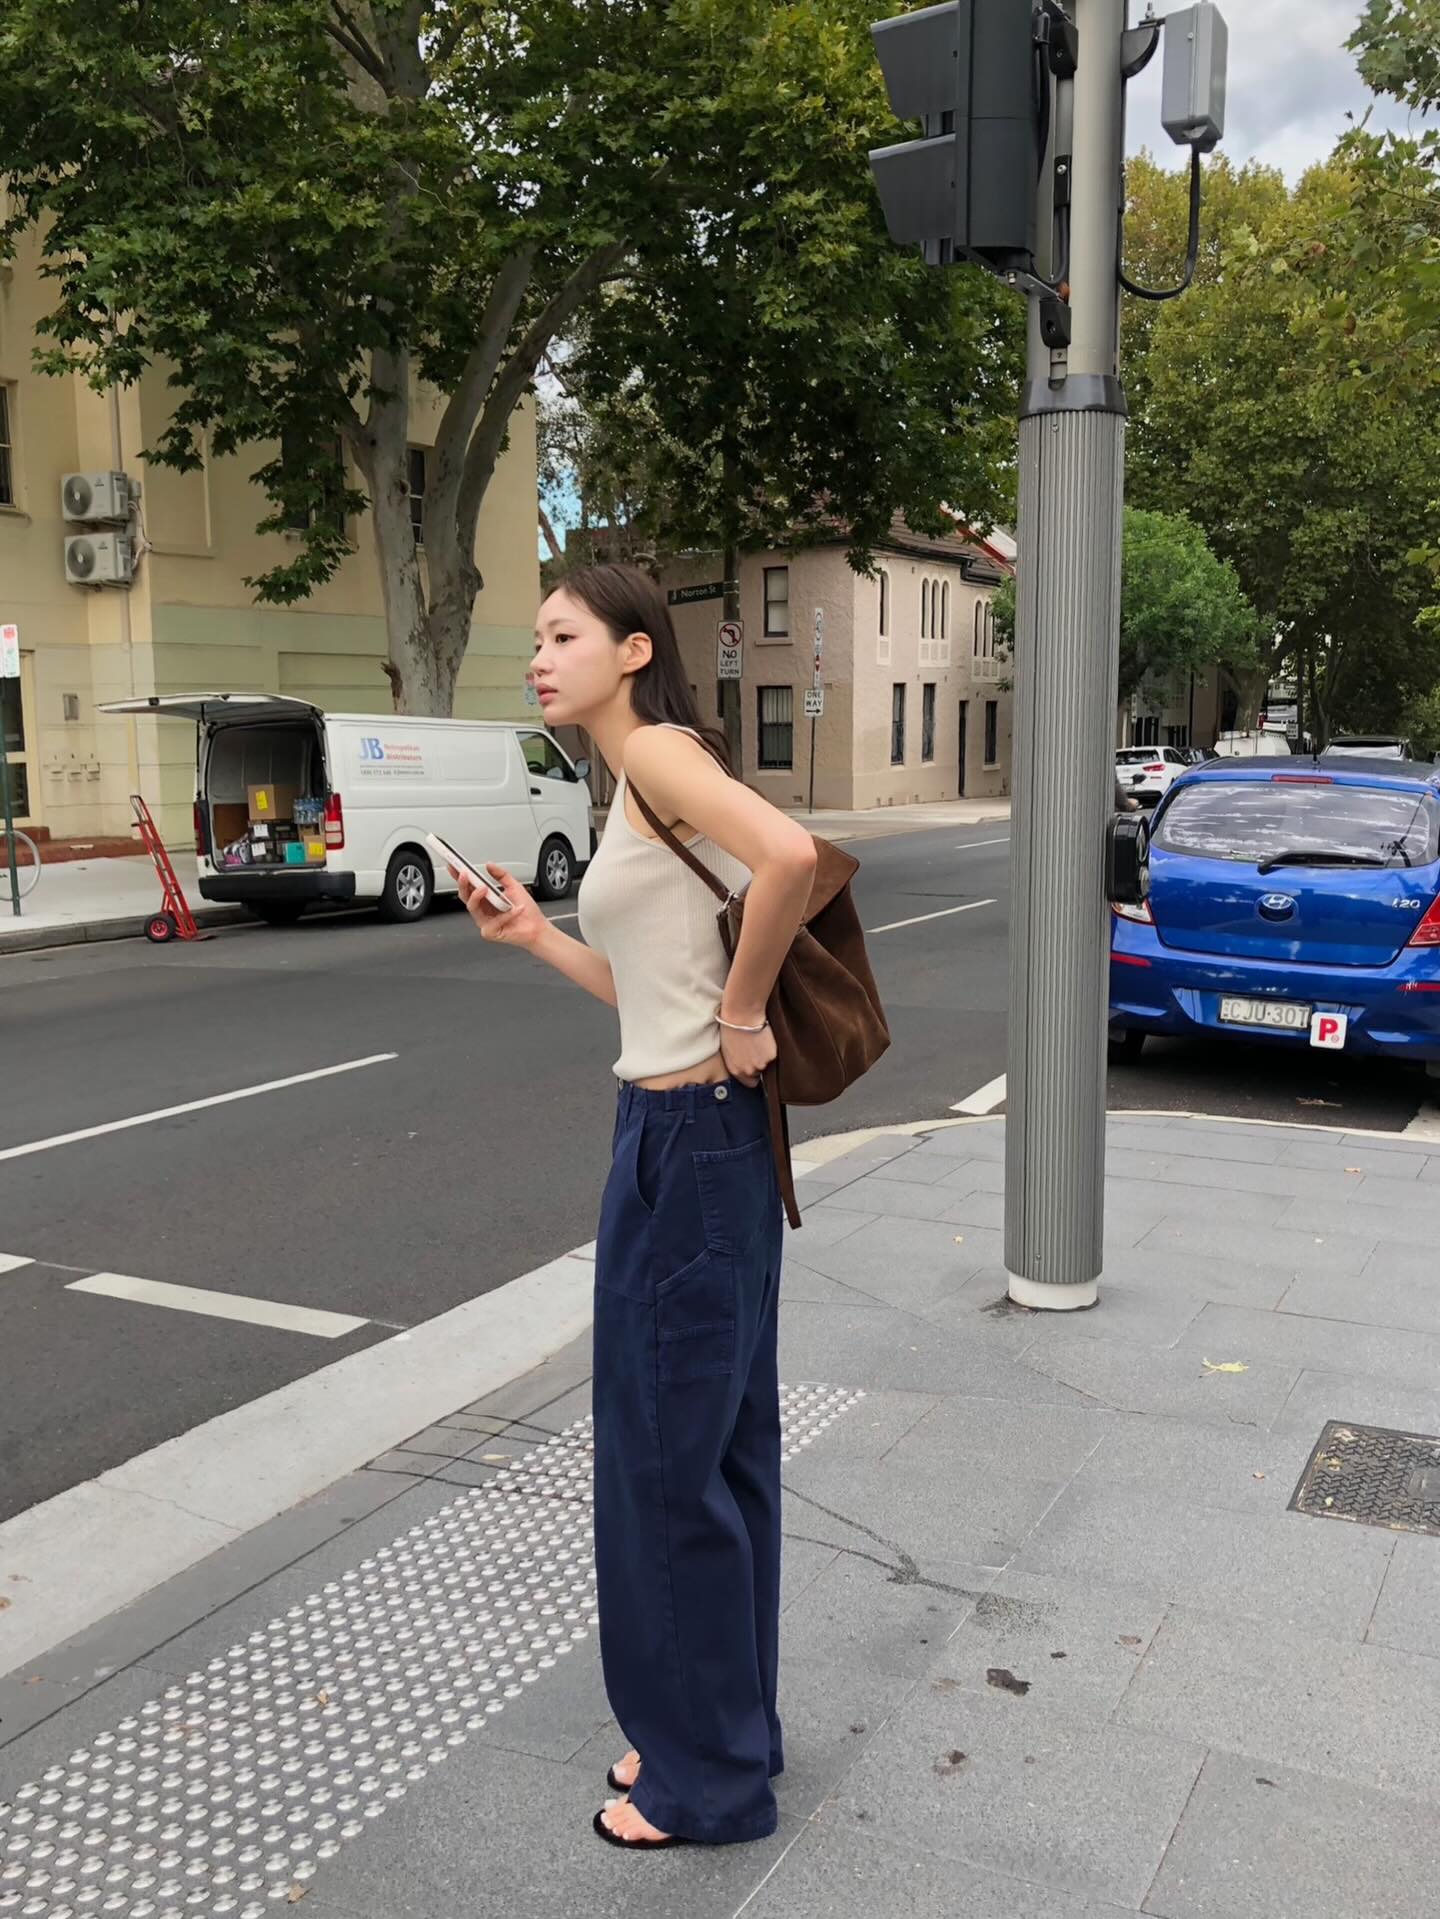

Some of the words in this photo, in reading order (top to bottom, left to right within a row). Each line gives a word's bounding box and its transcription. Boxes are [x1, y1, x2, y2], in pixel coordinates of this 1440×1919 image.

[681, 588, 708, 598] Norton
[710, 585, 717, 594] St
[722, 649, 737, 659] NO
[720, 660, 738, 668] LEFT
[806, 691, 821, 699] ONE
[358, 738, 384, 760] JB
[1318, 1017, 1338, 1042] P
